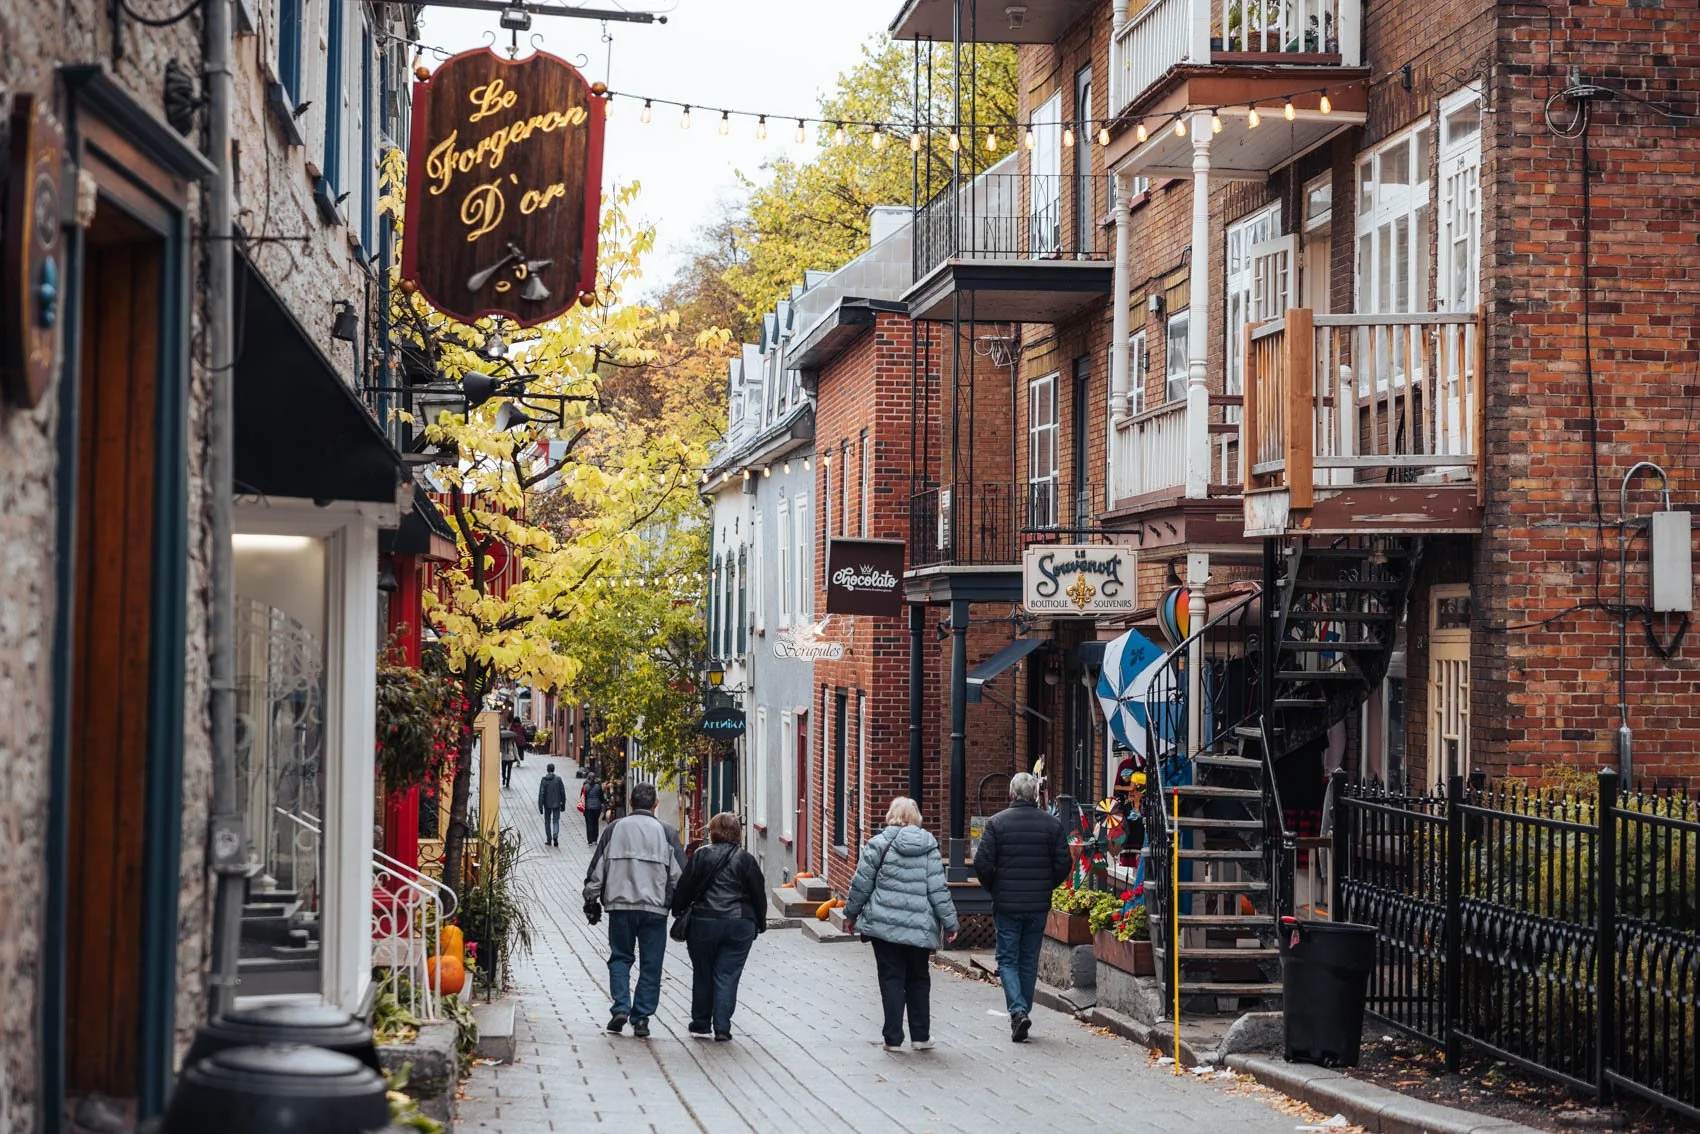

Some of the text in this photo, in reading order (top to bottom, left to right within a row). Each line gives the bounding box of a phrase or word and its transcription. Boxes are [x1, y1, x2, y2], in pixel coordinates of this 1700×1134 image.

[469, 79, 518, 123] Le
[426, 105, 588, 195] Forgeron
[832, 567, 899, 591] Chocolato
[1030, 599, 1132, 608] BOUTIQUE SOUVENIRS
[774, 642, 842, 660] Scrupules
